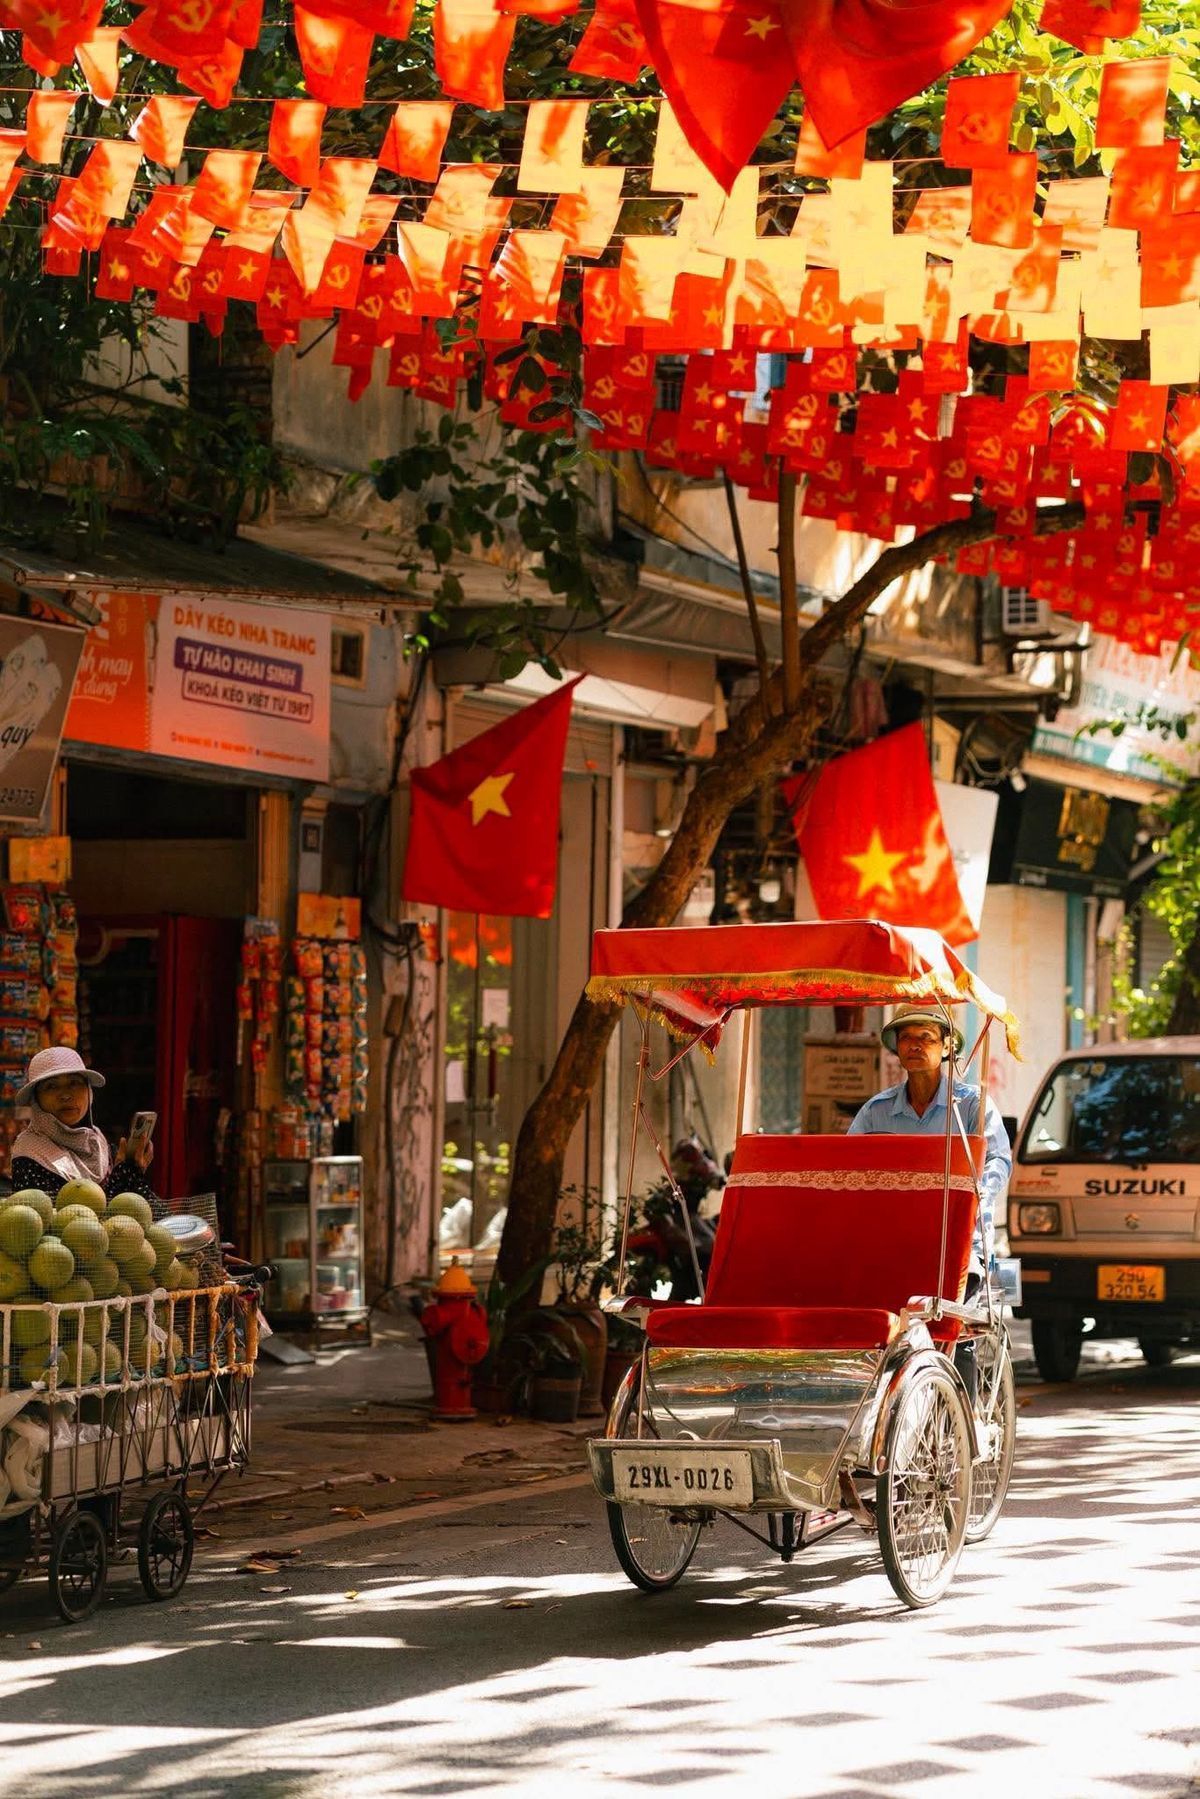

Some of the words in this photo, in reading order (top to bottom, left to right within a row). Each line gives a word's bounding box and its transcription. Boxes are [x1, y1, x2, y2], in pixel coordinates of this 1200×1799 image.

[207, 612, 235, 637] KÉO
[239, 621, 269, 645] NHA
[271, 629, 317, 656] TRANG
[203, 648, 232, 672] HÀO
[233, 656, 265, 680] KHAI
[266, 664, 297, 686] SINH
[1084, 1179, 1187, 1196] SUZUKI
[628, 1466, 734, 1491] 29XL-0026
